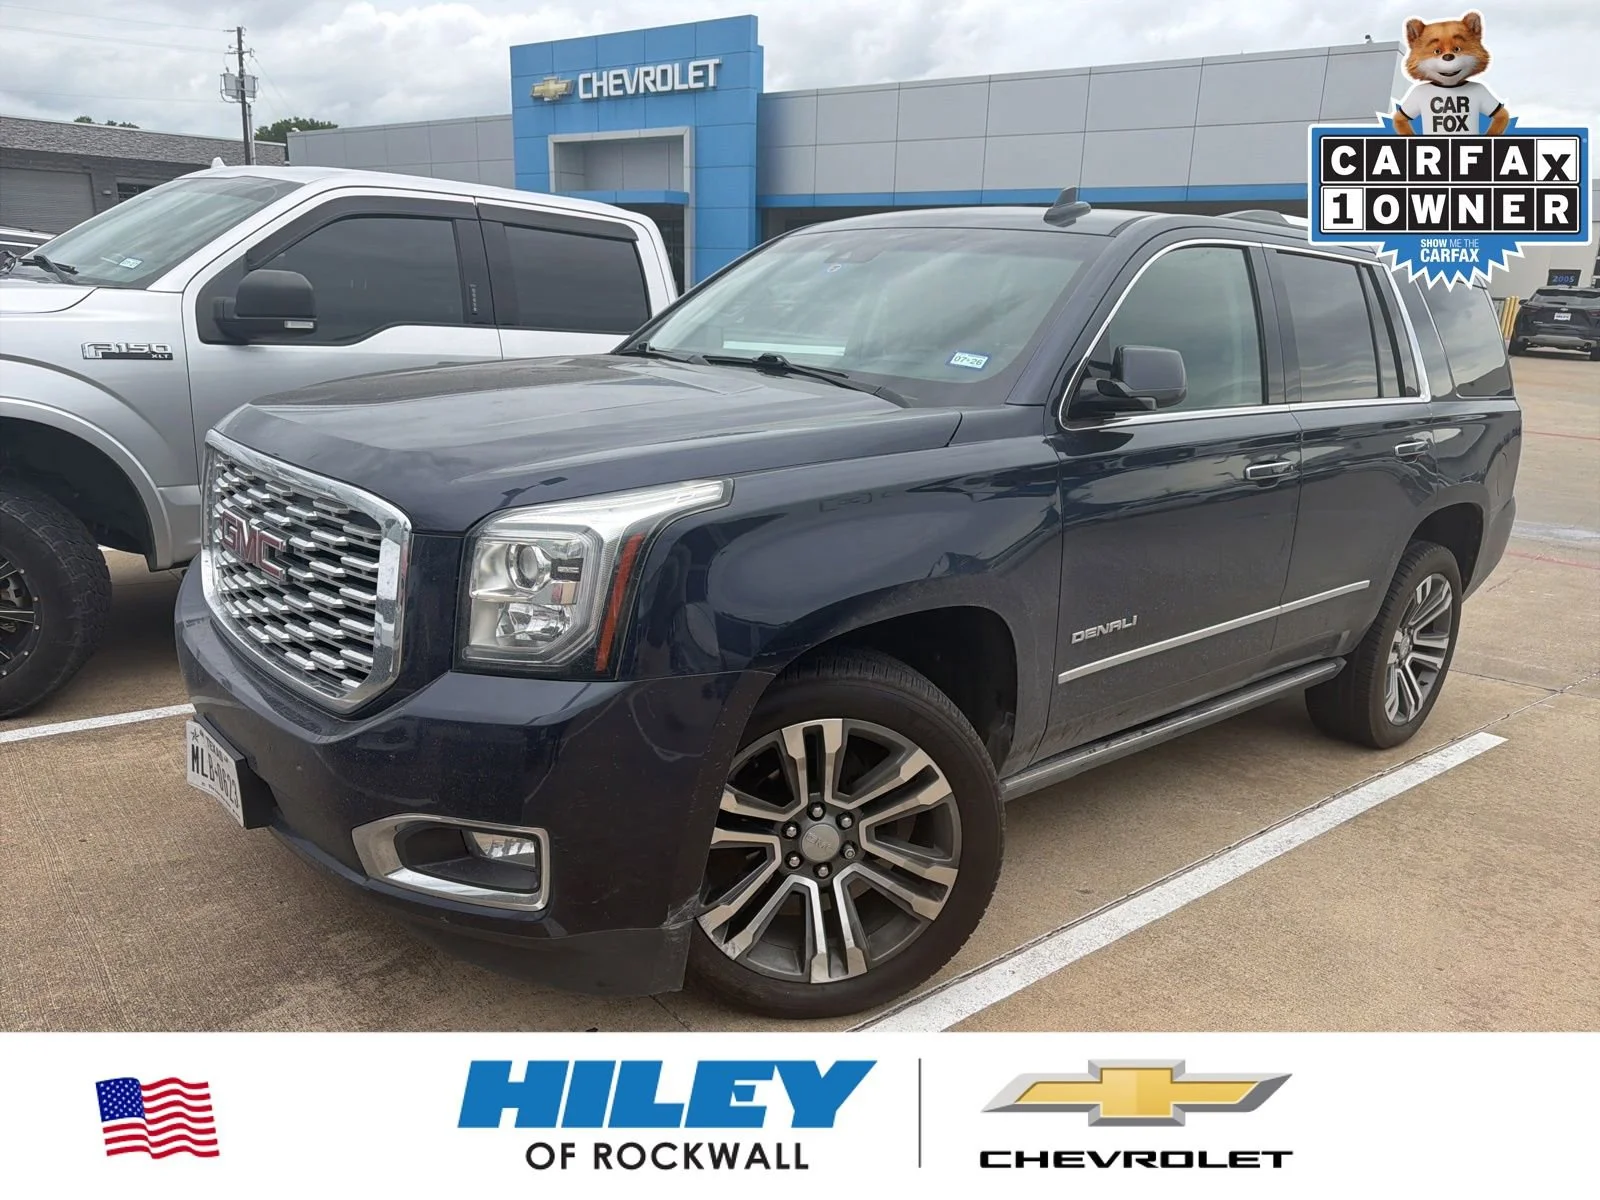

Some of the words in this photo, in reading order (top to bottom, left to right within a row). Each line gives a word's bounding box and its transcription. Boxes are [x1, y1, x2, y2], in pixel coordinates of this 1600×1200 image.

[579, 58, 721, 99] CHEVROLET
[221, 508, 286, 583] GMC
[1071, 614, 1138, 645] DENALI
